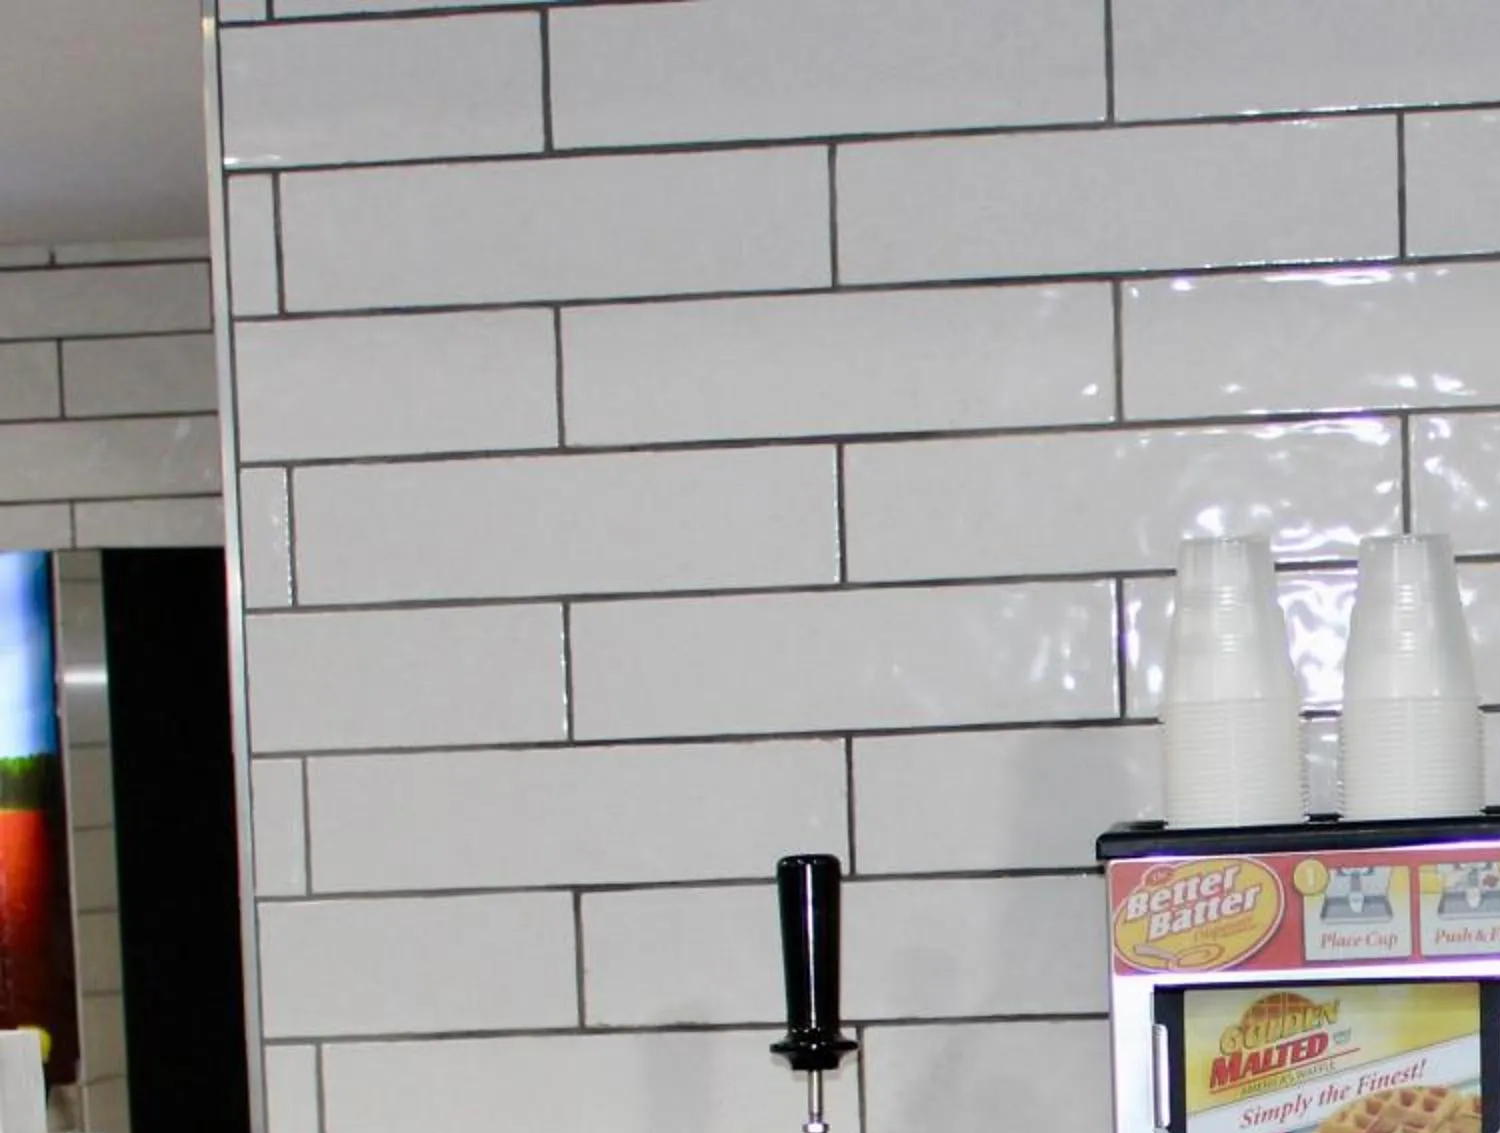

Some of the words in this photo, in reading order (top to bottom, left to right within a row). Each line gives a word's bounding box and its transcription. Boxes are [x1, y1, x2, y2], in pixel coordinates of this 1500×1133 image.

[1126, 864, 1242, 921] Better
[1148, 885, 1262, 941] Batter
[1319, 930, 1361, 948] Place
[1365, 929, 1399, 950] Cup
[1434, 927, 1473, 945] Push
[1219, 997, 1342, 1056] GOLDEN
[1210, 1031, 1329, 1088] MALTED
[1240, 1093, 1313, 1128] Simply
[1318, 1083, 1351, 1106] the
[1356, 1058, 1428, 1096] Finest!
